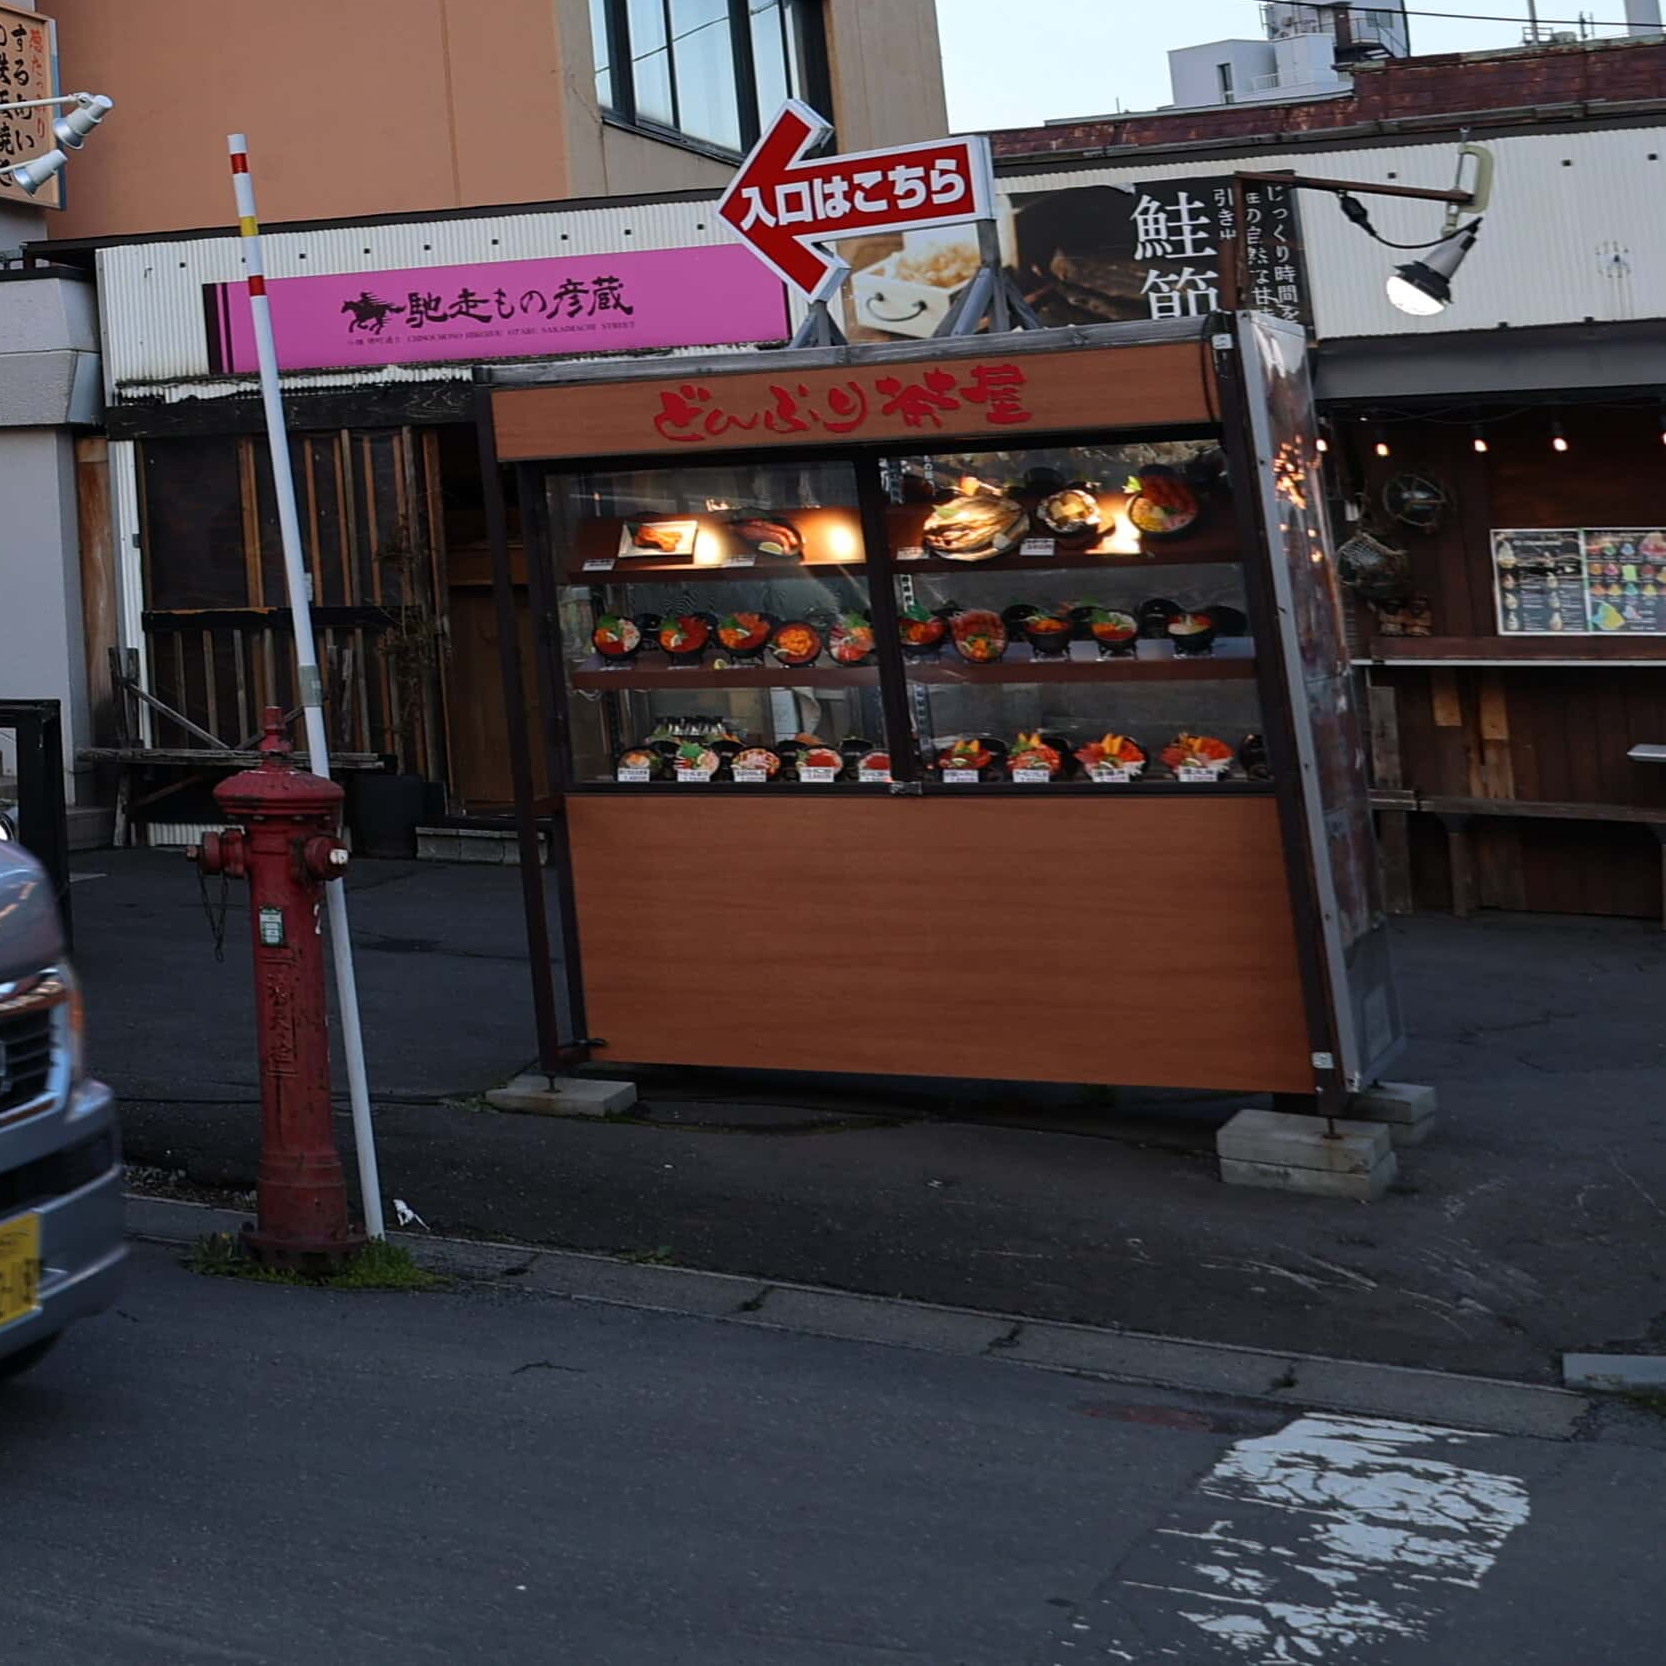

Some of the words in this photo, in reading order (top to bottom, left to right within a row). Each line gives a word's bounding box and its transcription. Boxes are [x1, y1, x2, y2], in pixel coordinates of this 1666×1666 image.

[740, 157, 967, 231] 入口はこちら
[405, 275, 634, 329] 馳走もの彦蔵
[653, 364, 1032, 442] どんぶり茶屋
